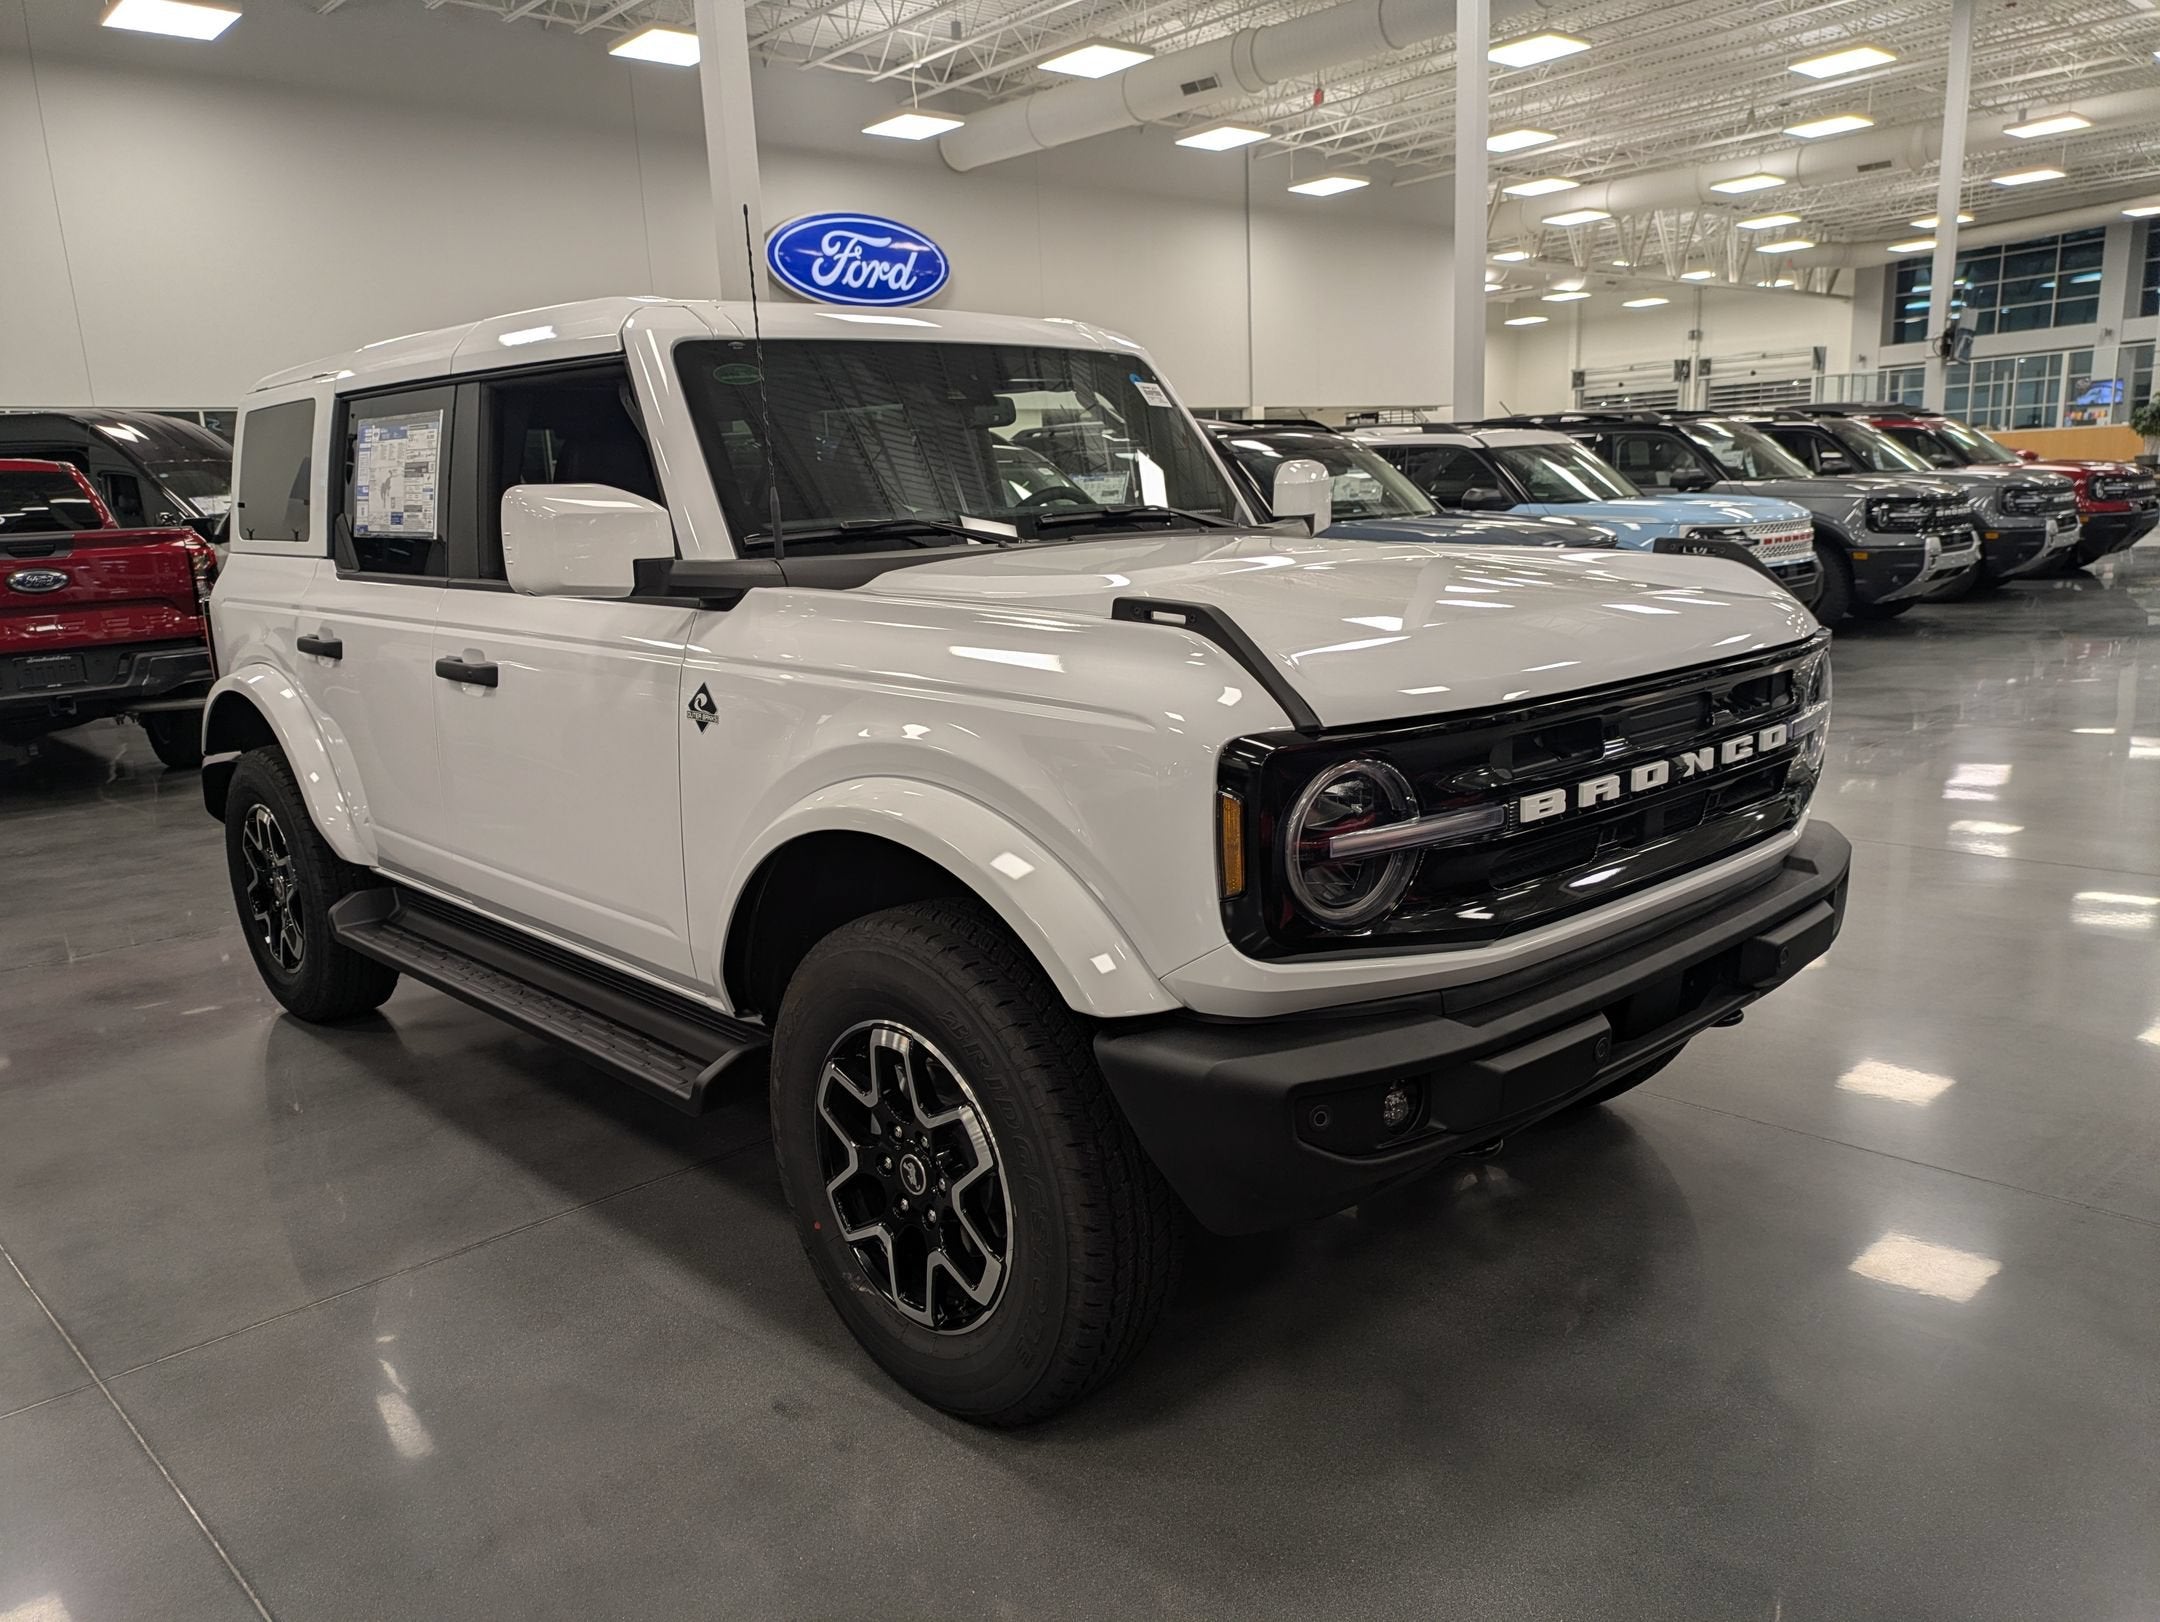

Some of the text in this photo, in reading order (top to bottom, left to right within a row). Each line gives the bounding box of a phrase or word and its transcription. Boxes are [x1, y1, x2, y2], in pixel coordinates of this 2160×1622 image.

[811, 230, 919, 292] Ford
[1763, 533, 1812, 545] BRONCO
[1519, 723, 1787, 824] BRONCO
